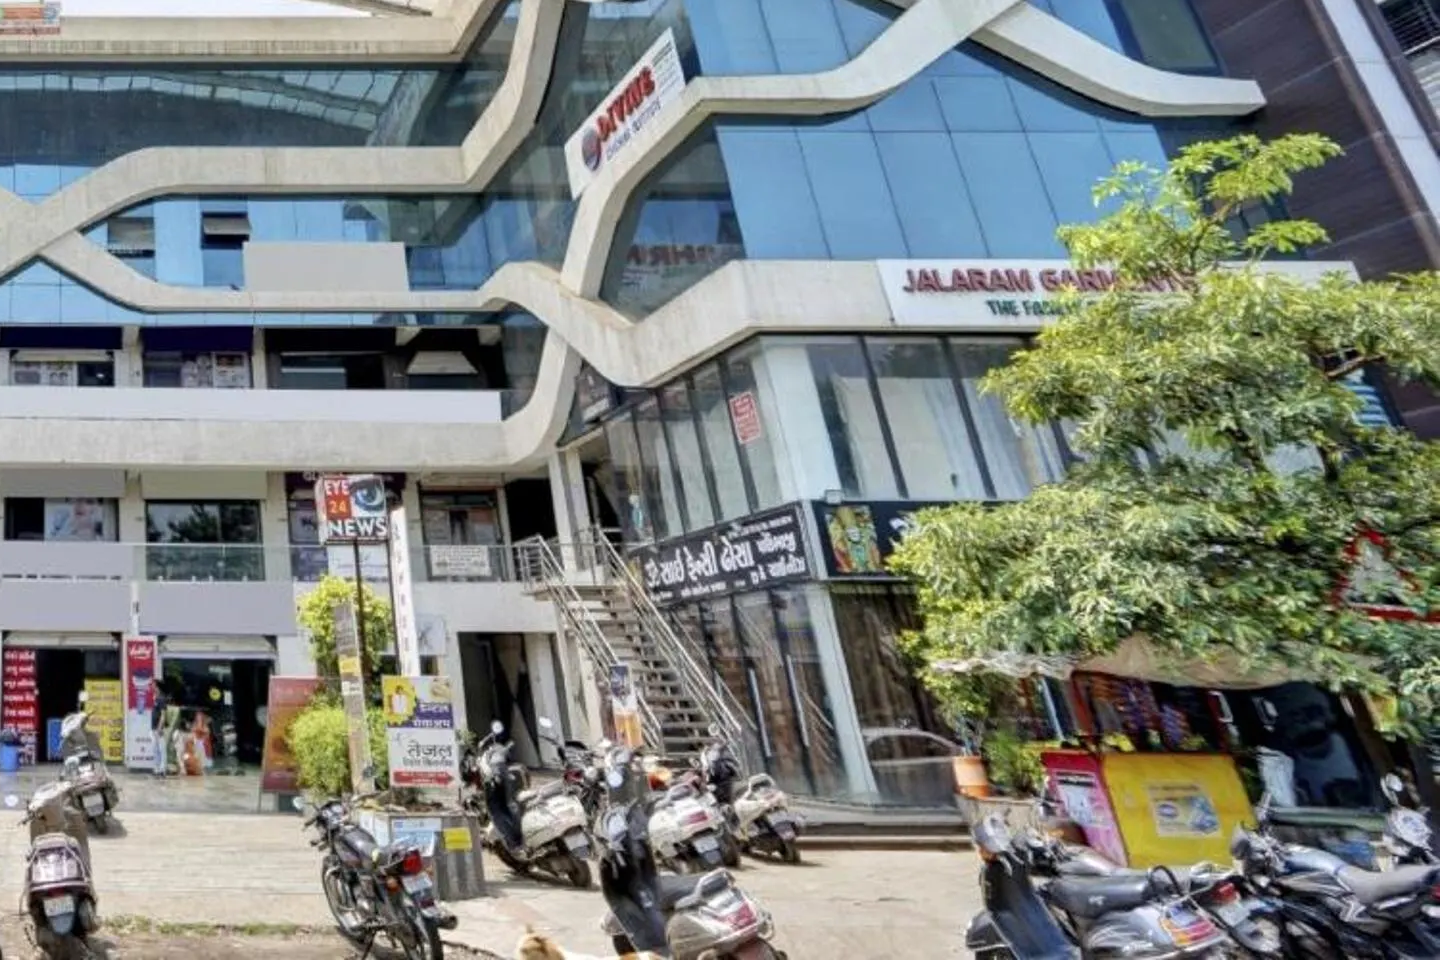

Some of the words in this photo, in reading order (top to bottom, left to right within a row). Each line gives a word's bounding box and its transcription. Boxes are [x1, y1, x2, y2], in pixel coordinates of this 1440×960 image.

[903, 268, 1036, 292] JALARAM
[985, 299, 1020, 316] THE
[324, 479, 350, 496] EYE
[327, 500, 348, 514] 24
[327, 518, 388, 537] NEWS
